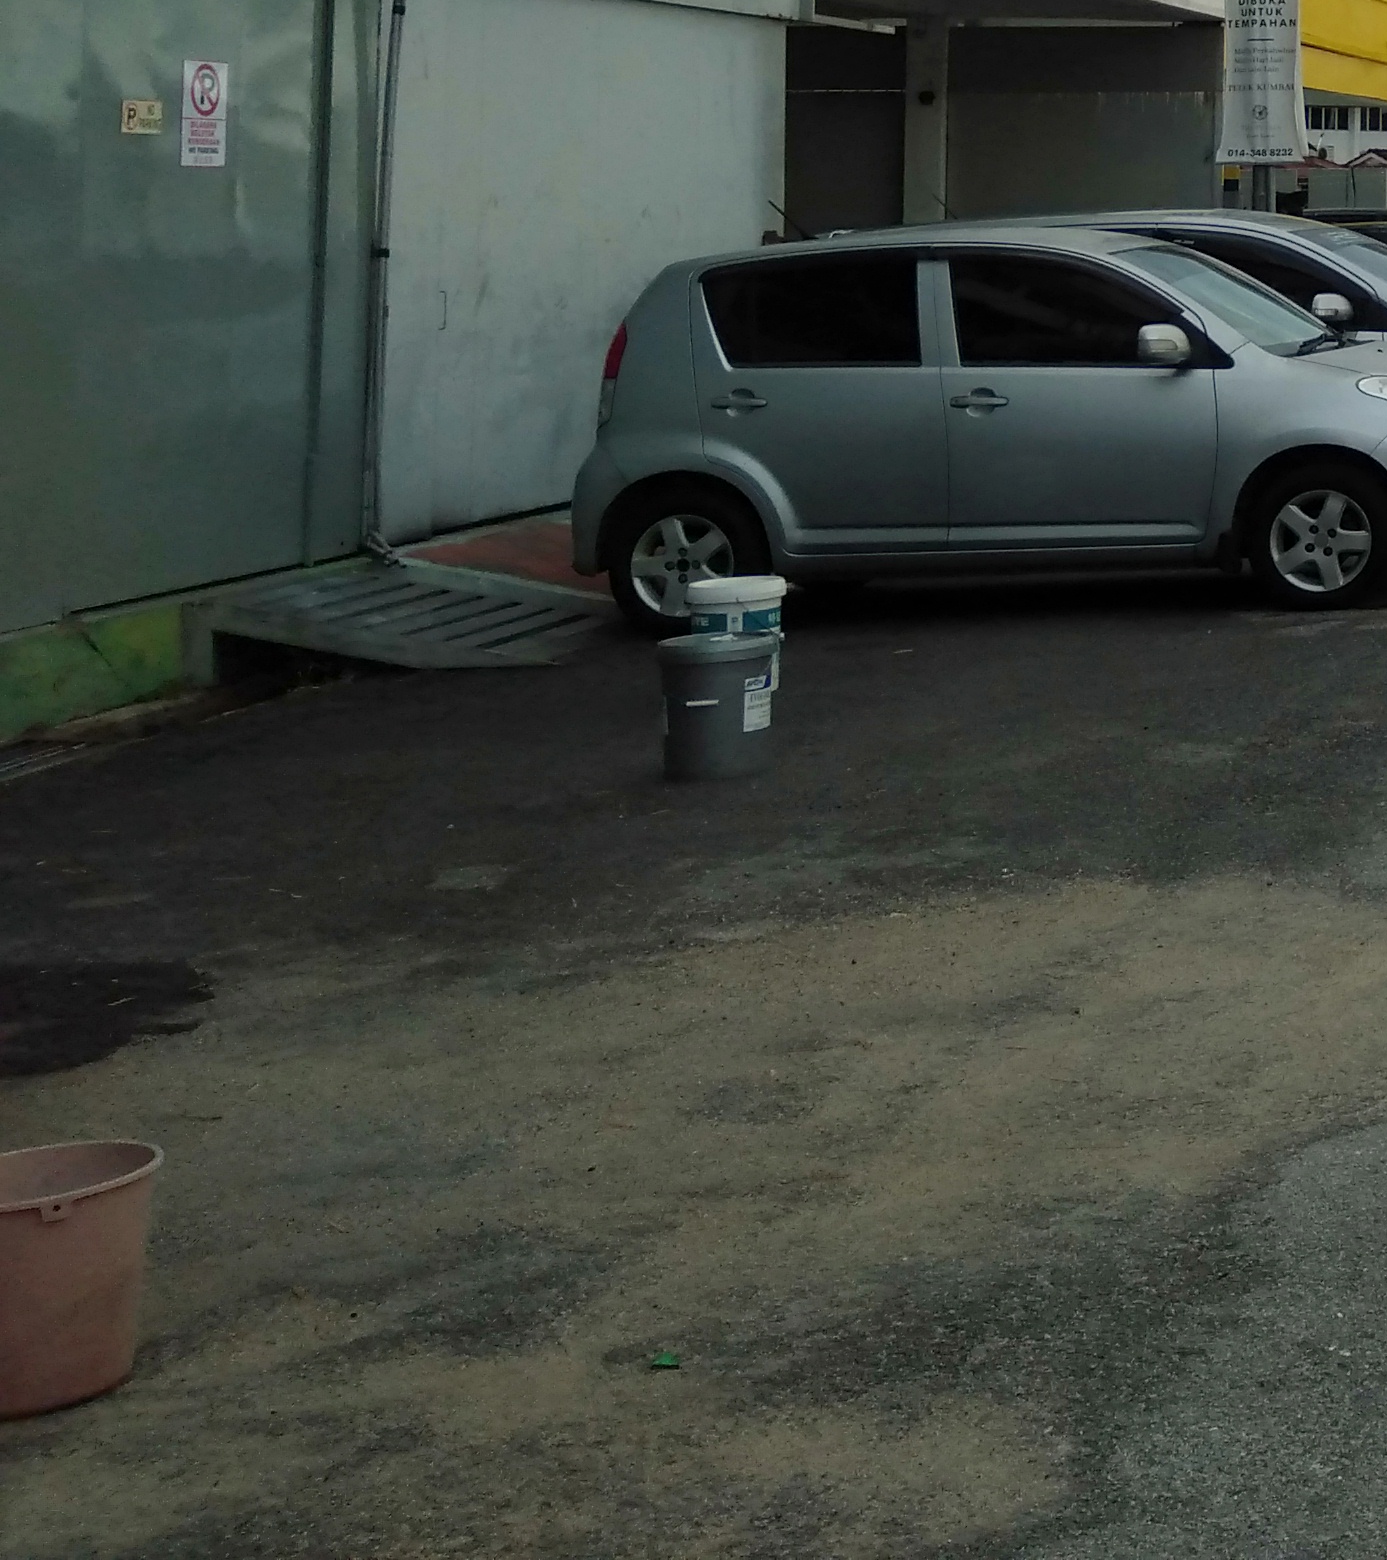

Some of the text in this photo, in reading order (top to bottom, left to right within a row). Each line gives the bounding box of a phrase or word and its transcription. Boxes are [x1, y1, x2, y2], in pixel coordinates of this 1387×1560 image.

[1241, 7, 1283, 17] UNTUK
[1228, 18, 1297, 28] TEMPAHAN
[1227, 148, 1293, 157] 014-348 8232
